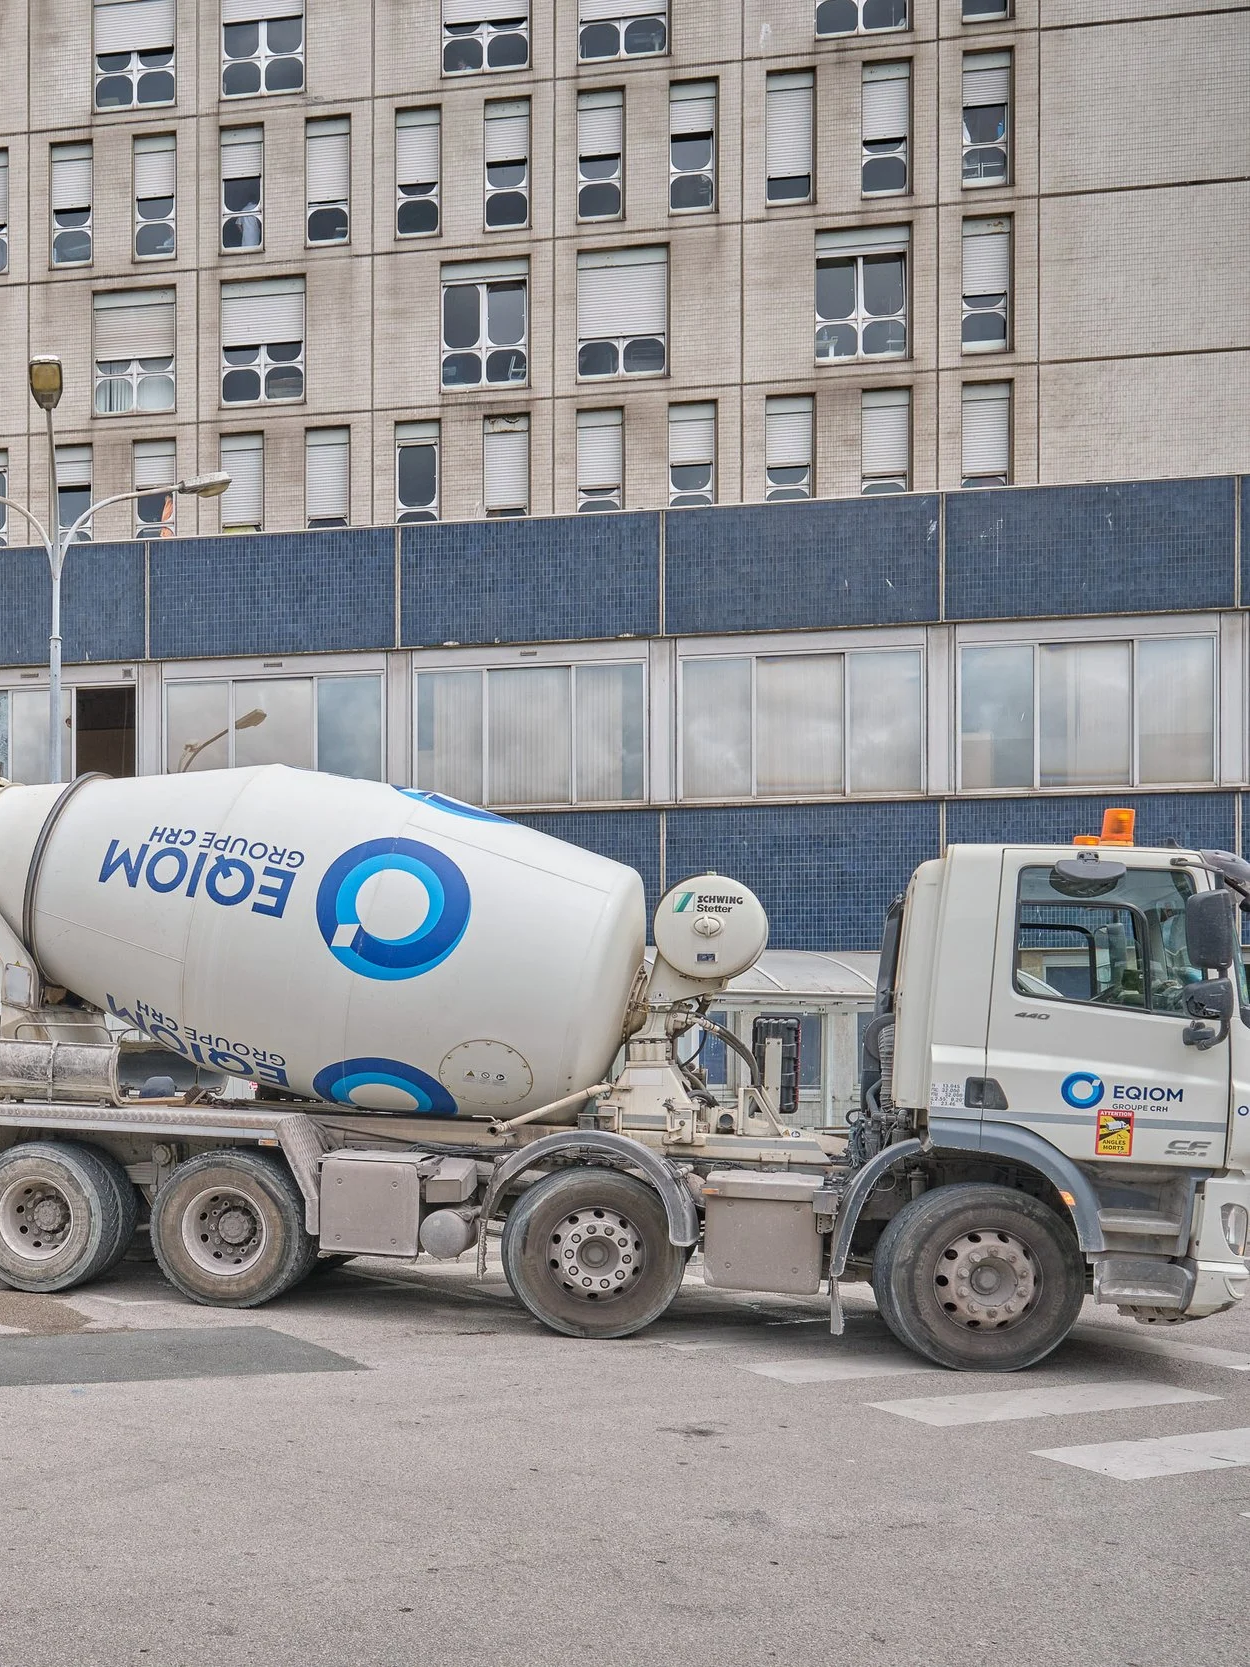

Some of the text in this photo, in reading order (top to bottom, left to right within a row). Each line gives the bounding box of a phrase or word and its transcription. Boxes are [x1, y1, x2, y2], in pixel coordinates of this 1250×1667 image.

[148, 826, 305, 869] GROUPE CRH
[98, 839, 297, 919] EQIOM
[697, 895, 743, 904] SCHWING
[696, 904, 733, 913] Stetter
[1014, 1012, 1051, 1020] 440
[136, 999, 286, 1067] GROUPE CRH
[1113, 1085, 1184, 1102] EQIOM
[1112, 1103, 1168, 1113] GROUPE CRH
[1167, 1140, 1212, 1151] CF
